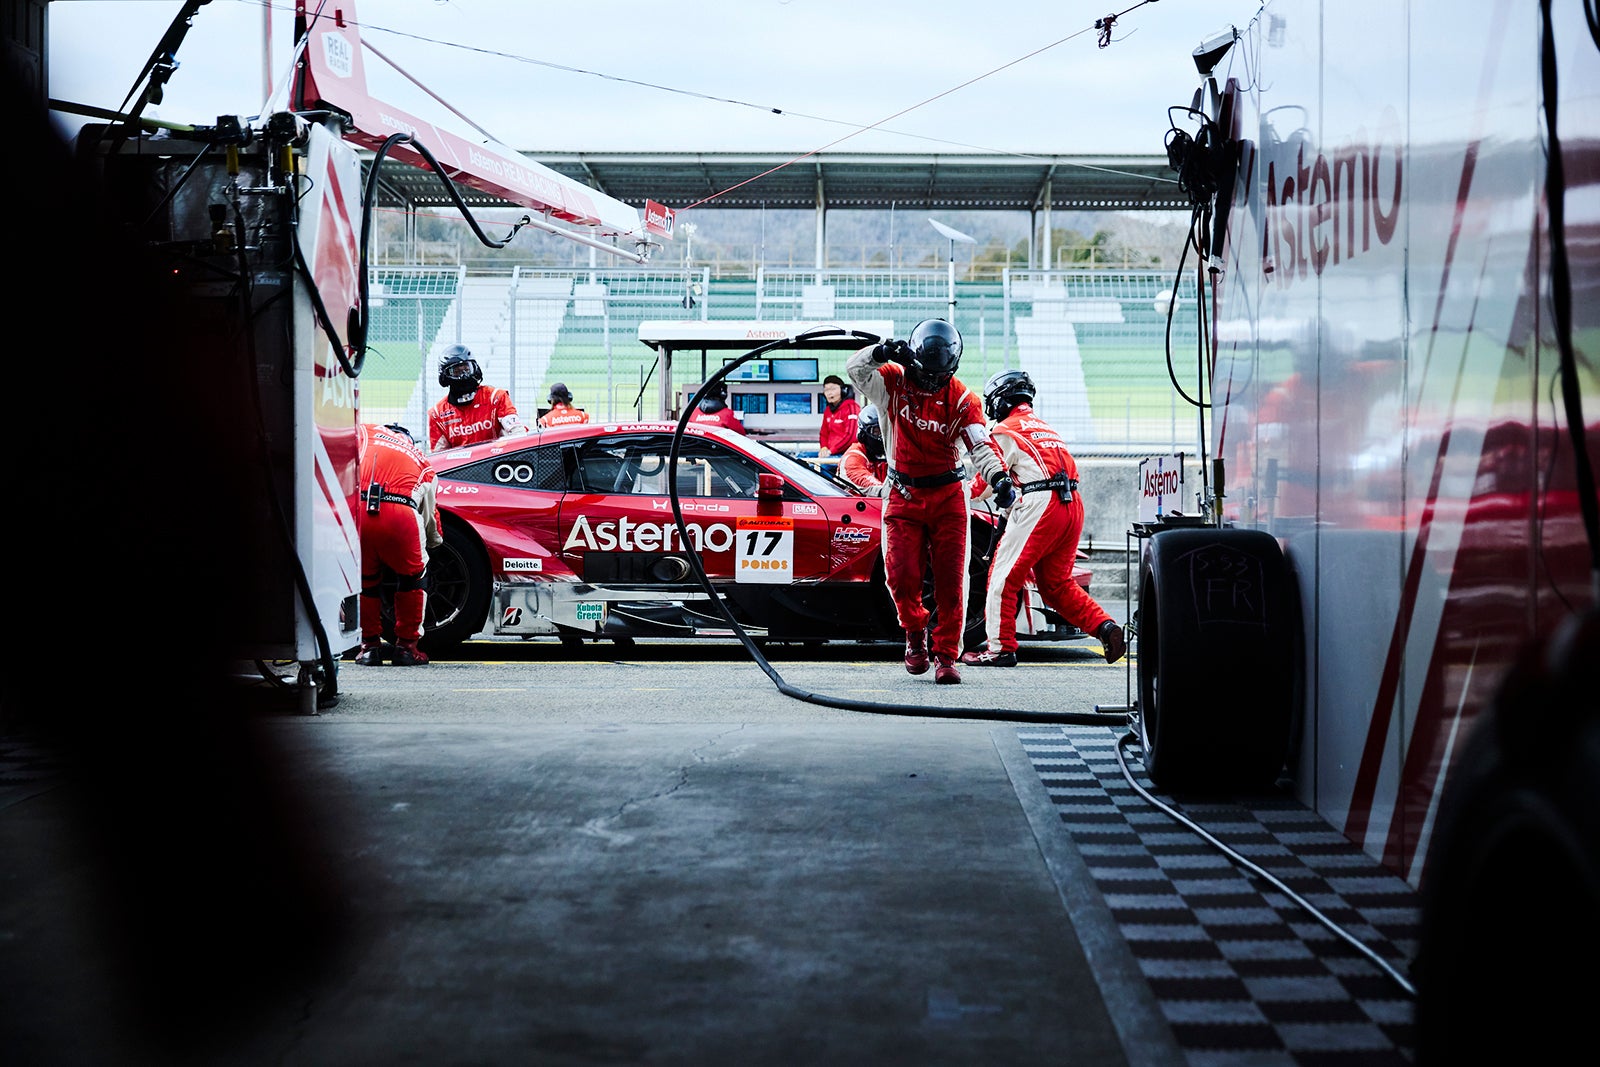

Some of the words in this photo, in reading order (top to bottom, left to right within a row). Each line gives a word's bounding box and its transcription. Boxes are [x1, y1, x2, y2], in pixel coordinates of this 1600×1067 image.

[327, 36, 349, 61] REAL
[468, 146, 503, 177] Astemo
[1262, 105, 1403, 290] Astemo
[745, 329, 786, 339] Astemo
[448, 419, 493, 438] Astemo
[552, 415, 582, 425] Astemo
[1143, 469, 1178, 498] Astemo
[381, 494, 408, 504] stemo
[563, 514, 734, 552] Astemo
[746, 531, 783, 556] 17
[834, 527, 873, 541] HRC
[741, 559, 788, 570] PONOS
[1205, 578, 1255, 613] FR
[576, 612, 602, 620] Green
